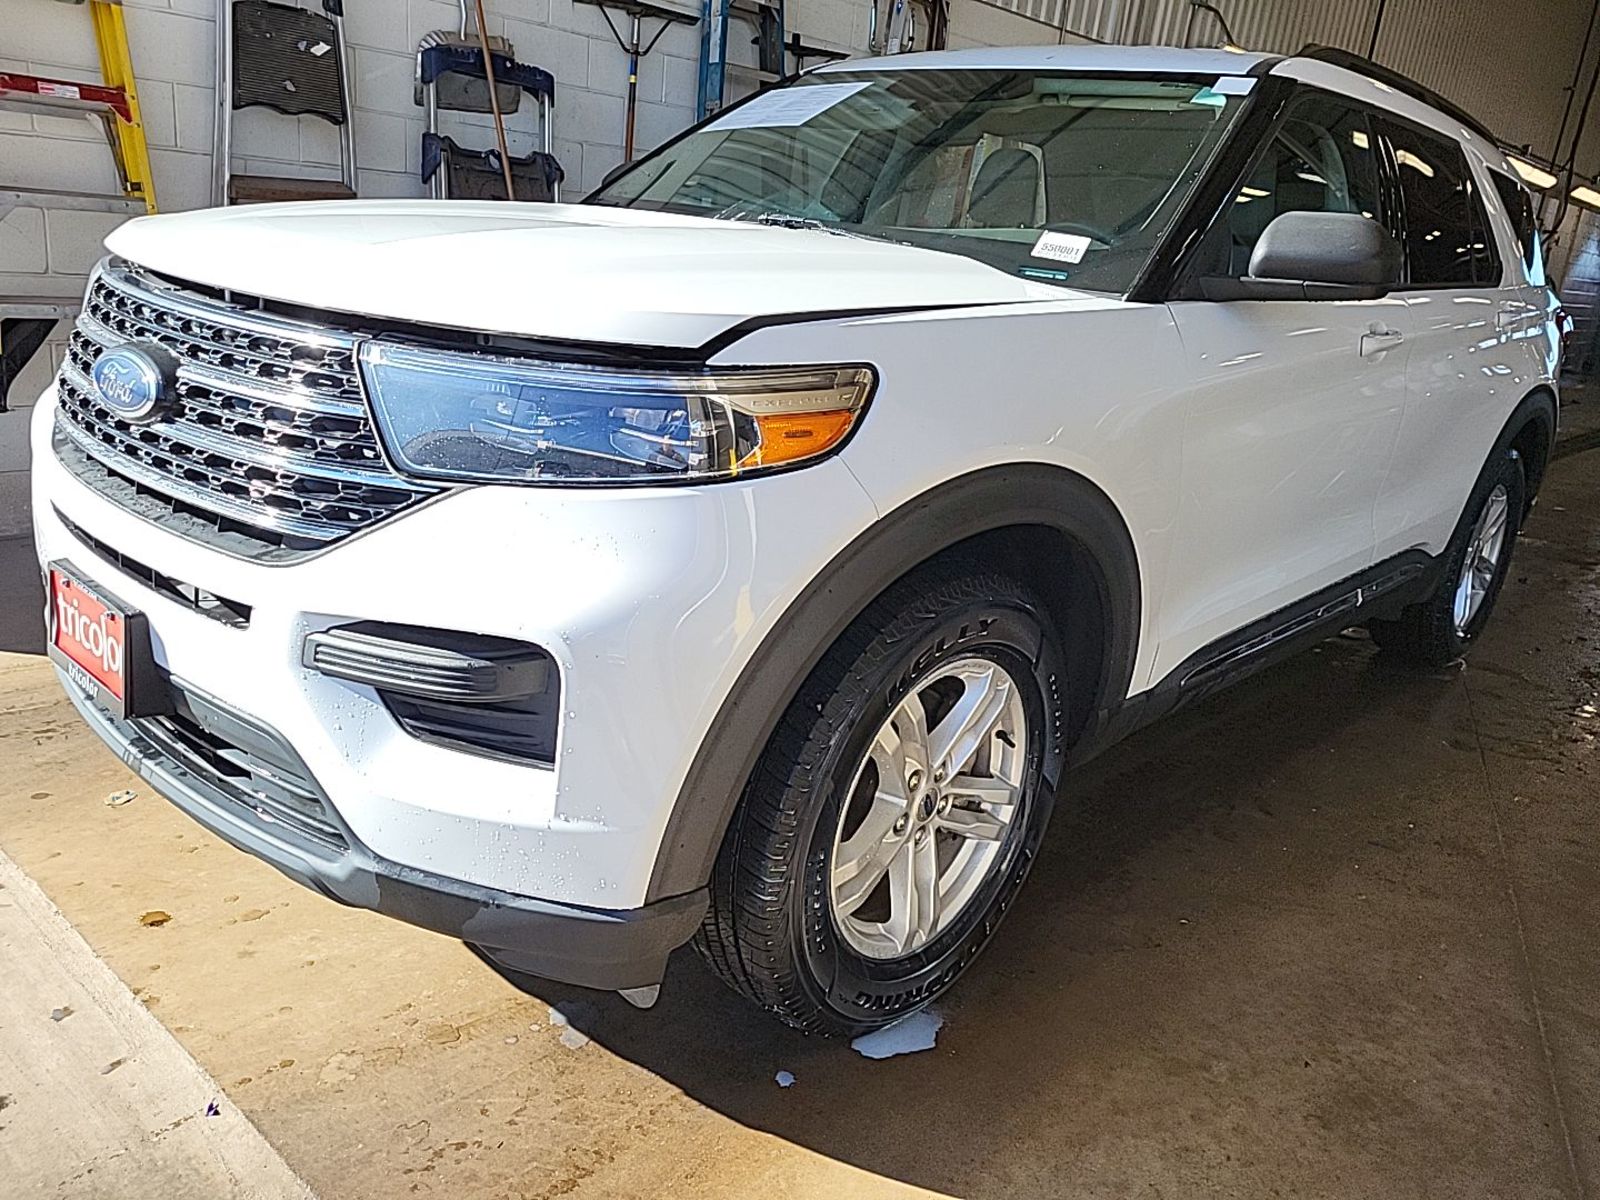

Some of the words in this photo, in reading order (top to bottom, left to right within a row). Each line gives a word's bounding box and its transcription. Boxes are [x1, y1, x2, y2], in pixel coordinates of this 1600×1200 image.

[100, 361, 137, 403] Ford
[68, 662, 99, 697] tricolor
[886, 617, 999, 708] KELLY
